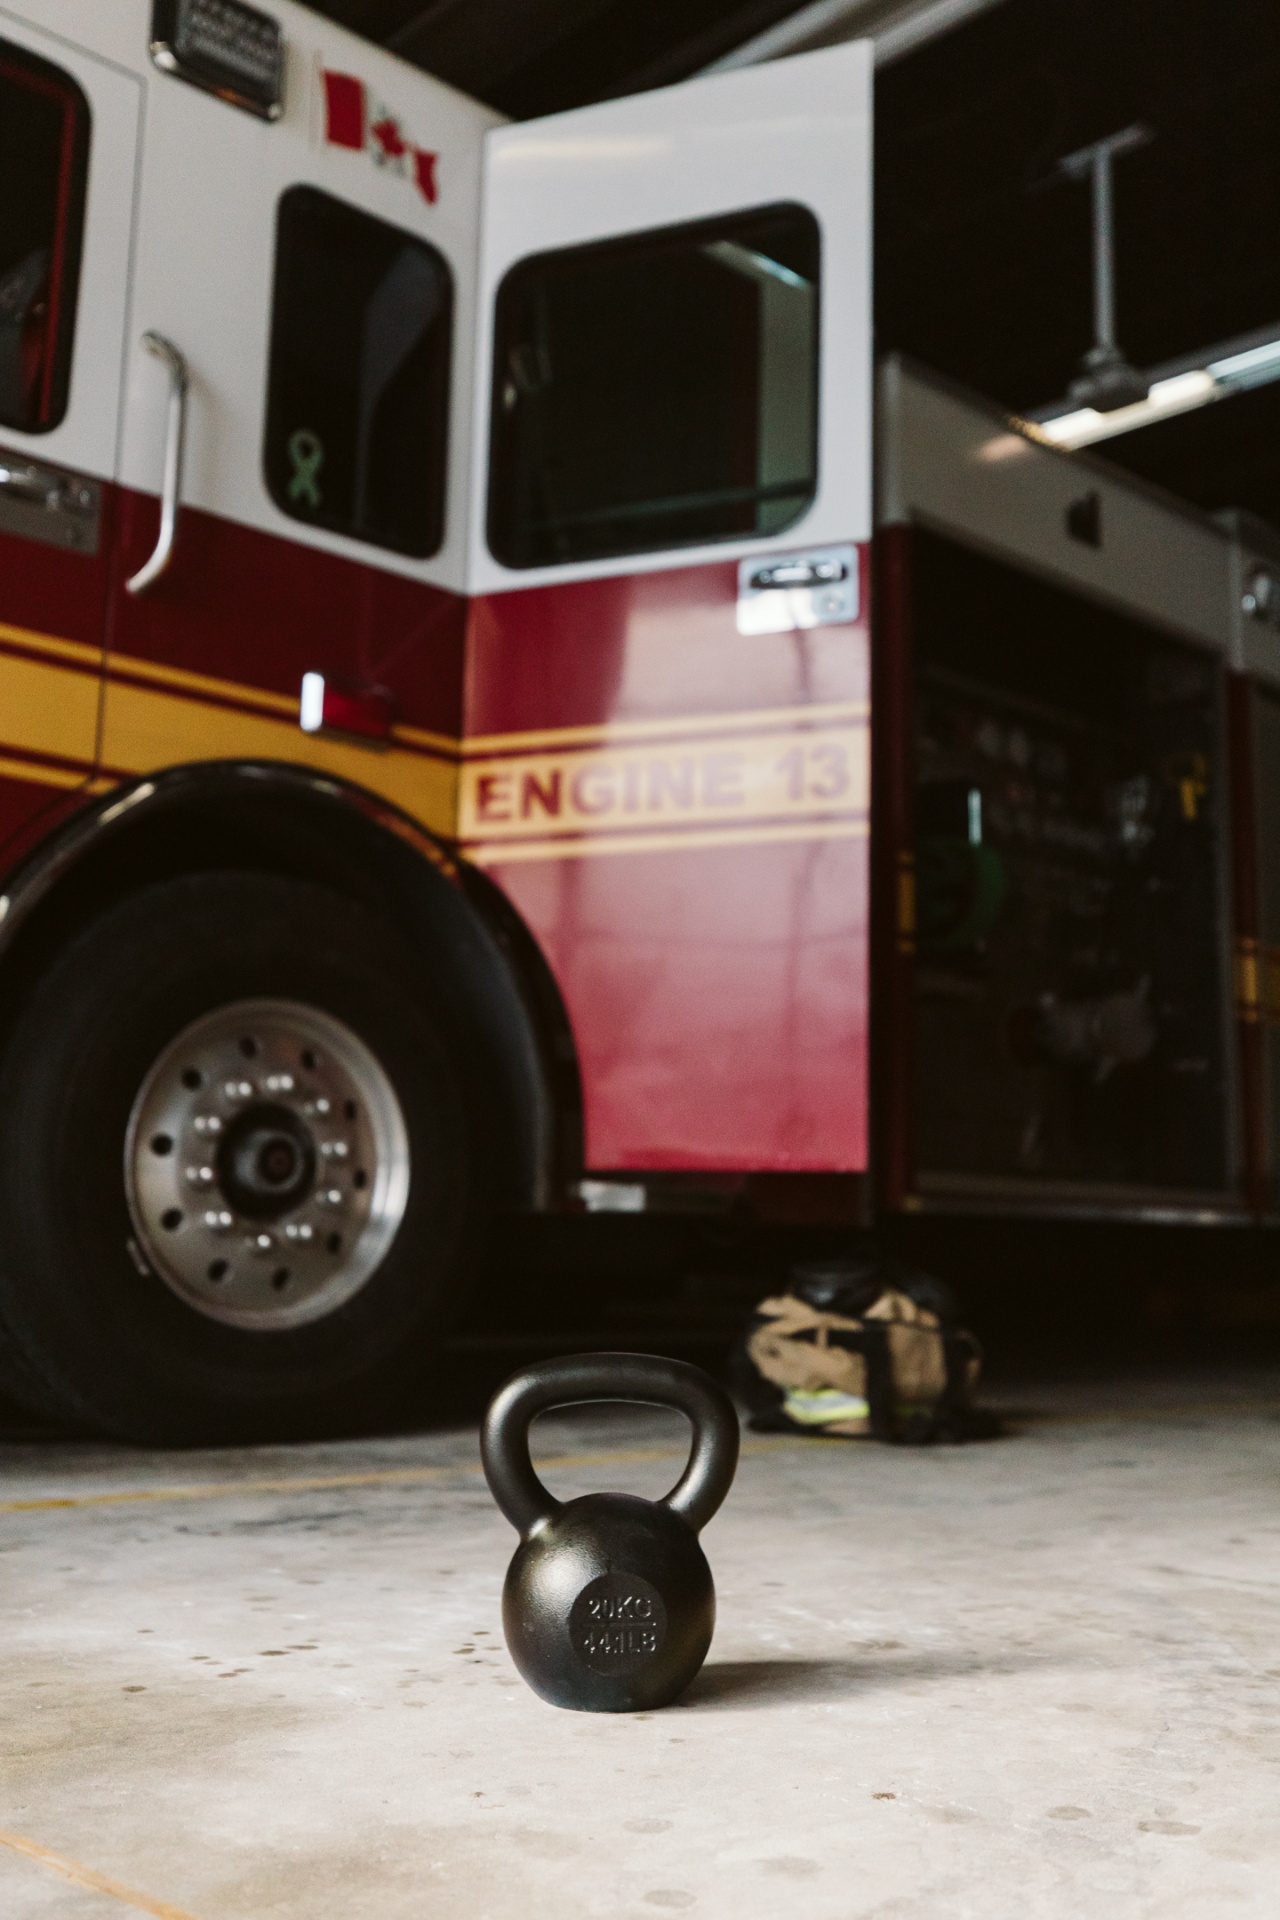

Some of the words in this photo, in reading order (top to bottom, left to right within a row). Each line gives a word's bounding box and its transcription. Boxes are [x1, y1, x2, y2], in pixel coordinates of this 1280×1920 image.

[475, 752, 746, 825] ENGINE
[776, 744, 851, 802] 13
[587, 1596, 652, 1619] 20KG
